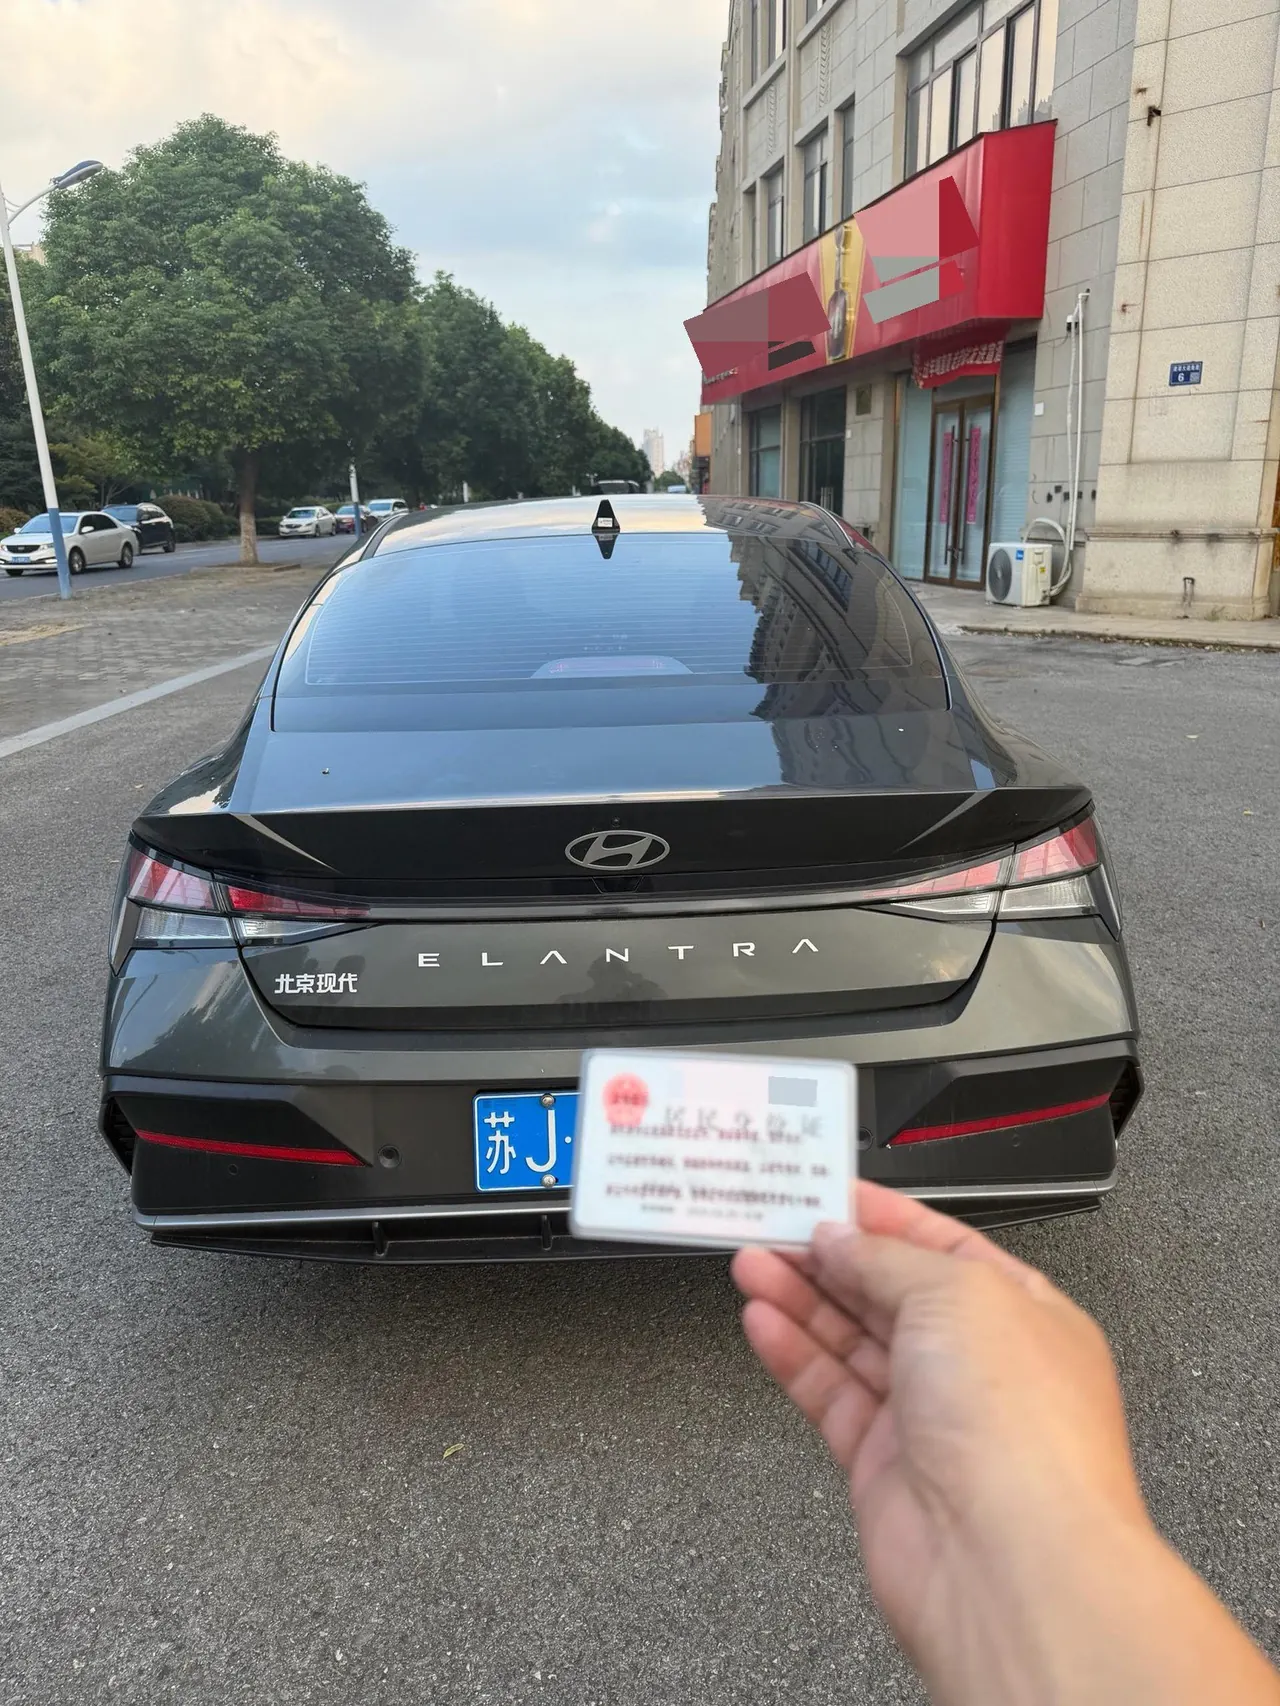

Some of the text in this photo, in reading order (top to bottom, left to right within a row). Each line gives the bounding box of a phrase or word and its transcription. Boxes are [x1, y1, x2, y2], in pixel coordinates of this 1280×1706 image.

[1177, 372, 1185, 382] 6
[418, 938, 819, 968] ELANTRA
[274, 972, 358, 994] 北京现代
